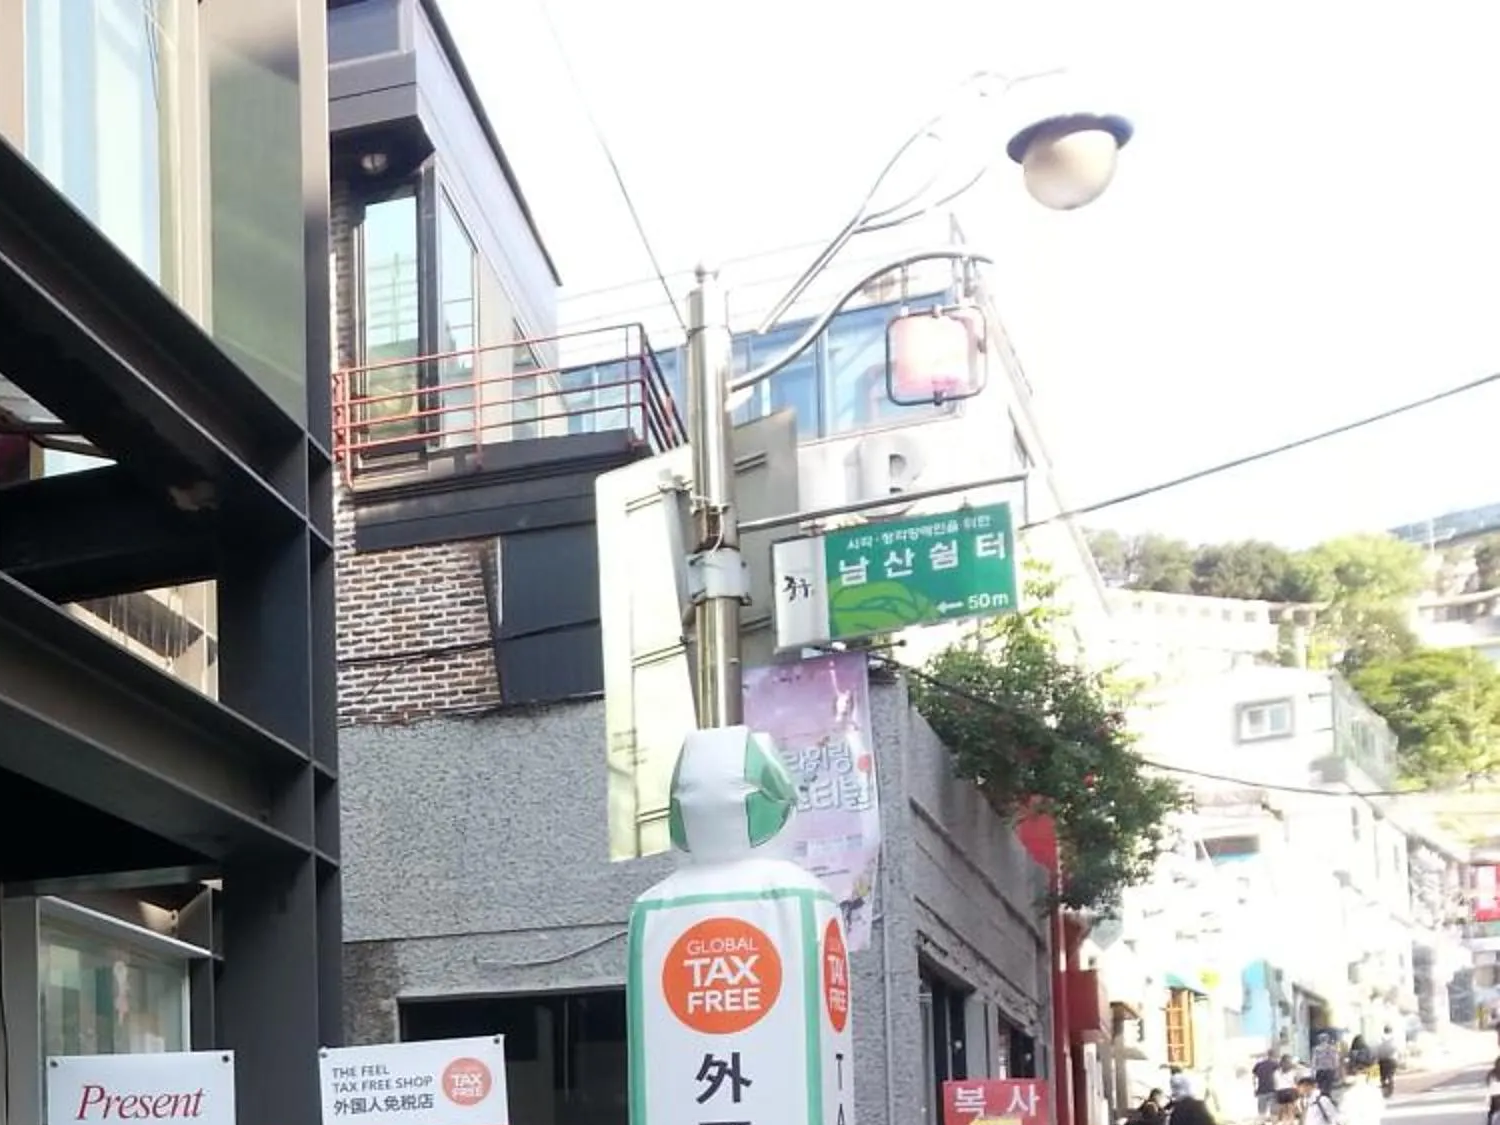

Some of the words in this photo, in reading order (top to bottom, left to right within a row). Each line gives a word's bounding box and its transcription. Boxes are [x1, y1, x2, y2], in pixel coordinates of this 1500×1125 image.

[967, 593, 1009, 610] 50m
[687, 936, 760, 956] GLOBAL
[683, 954, 762, 988] TAX
[687, 987, 762, 1014] FREE
[332, 1066, 357, 1079] THE
[362, 1064, 389, 1077] FEEL
[451, 1073, 483, 1087] TAX
[333, 1081, 358, 1094] TAX
[362, 1078, 392, 1091] FREE
[395, 1075, 434, 1089] SHOP
[76, 1084, 205, 1121] Present
